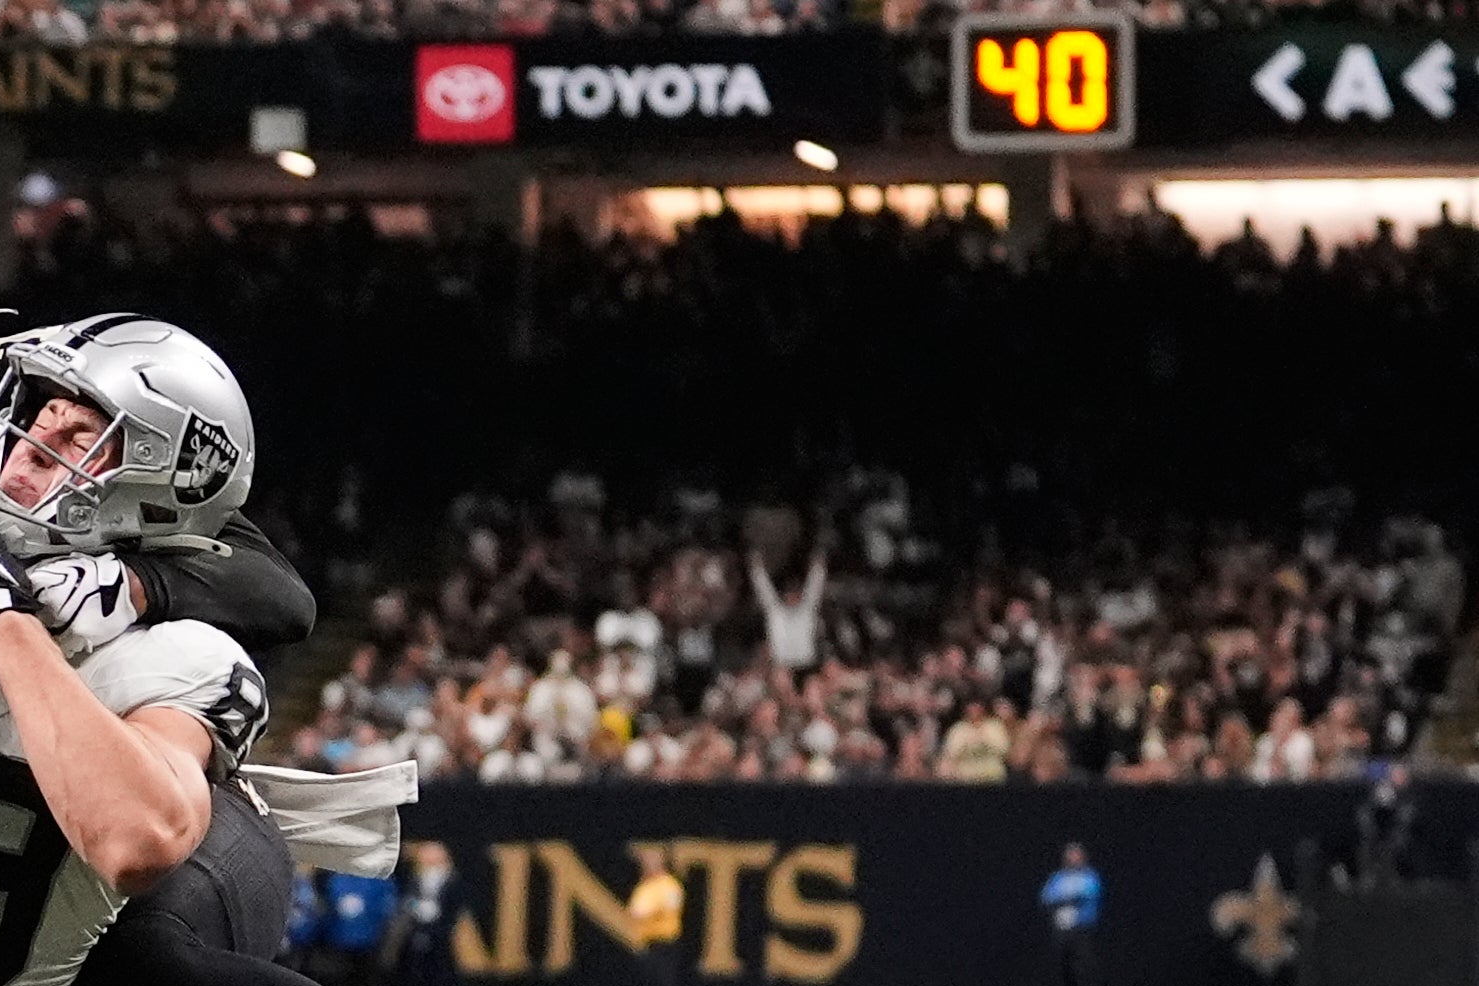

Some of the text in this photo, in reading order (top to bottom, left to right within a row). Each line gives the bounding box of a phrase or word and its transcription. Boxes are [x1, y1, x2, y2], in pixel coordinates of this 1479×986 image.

[529, 63, 771, 119] TOYOTA
[976, 30, 1109, 133] 40
[1250, 40, 1479, 122] CAE
[194, 418, 237, 459] RAIDERS
[450, 838, 866, 982] INTS
